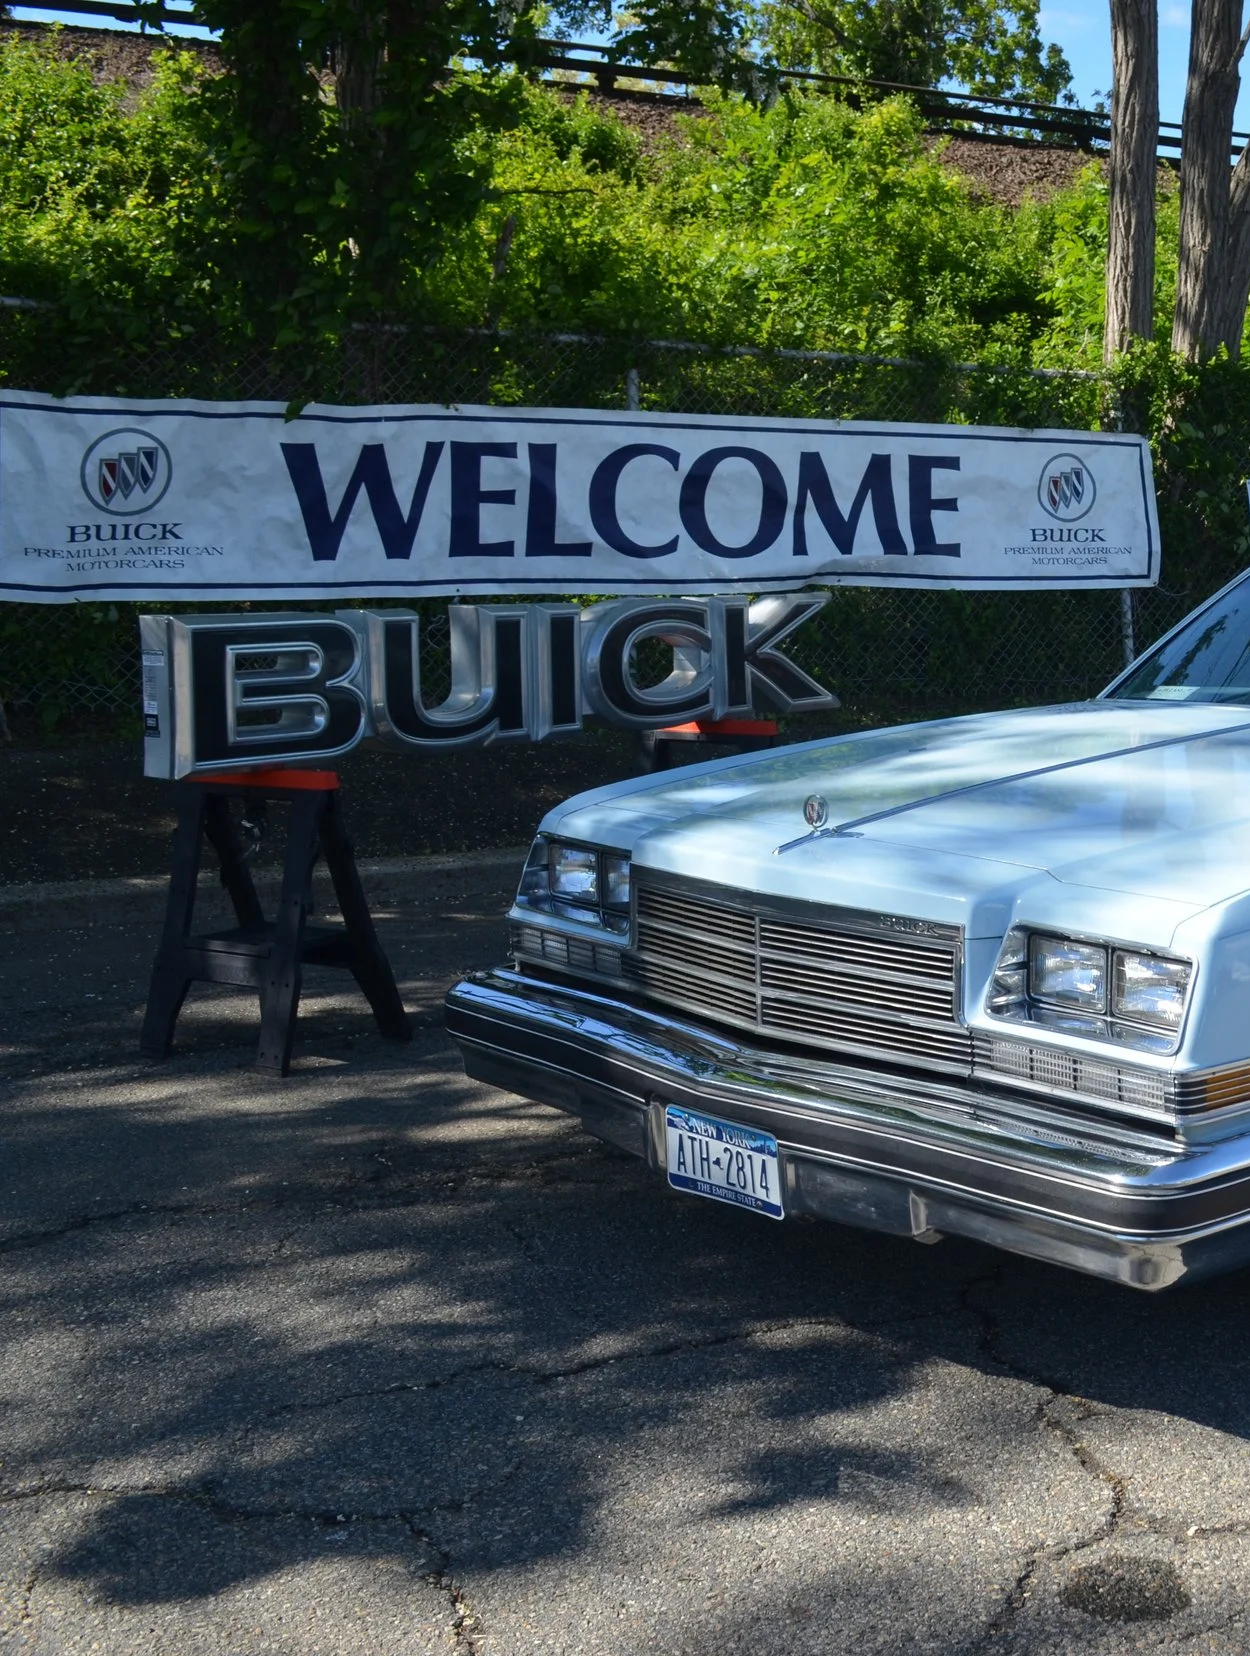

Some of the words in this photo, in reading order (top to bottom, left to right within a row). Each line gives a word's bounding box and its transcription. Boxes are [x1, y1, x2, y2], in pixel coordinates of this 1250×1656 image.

[280, 441, 961, 561] WELCOME
[66, 523, 184, 543] BUICK
[1030, 528, 1107, 543] BUICK
[24, 547, 117, 559] PREMIUM
[124, 546, 224, 556] AMERICAN
[1004, 547, 1064, 555] PREMIUM
[1068, 546, 1132, 555] AMERICAN
[66, 559, 185, 572] MOTORCARS
[1032, 556, 1107, 566] MOTORCARS
[160, 592, 841, 780] BUICK
[880, 916, 939, 936] BUICK
[692, 1117, 717, 1139] NEW
[721, 1126, 751, 1150] YORK
[677, 1133, 712, 1180] ATH
[723, 1146, 770, 1200] 2814
[697, 1182, 710, 1193] THE
[712, 1185, 736, 1200] EMPIRE
[737, 1193, 757, 1207] STATE
